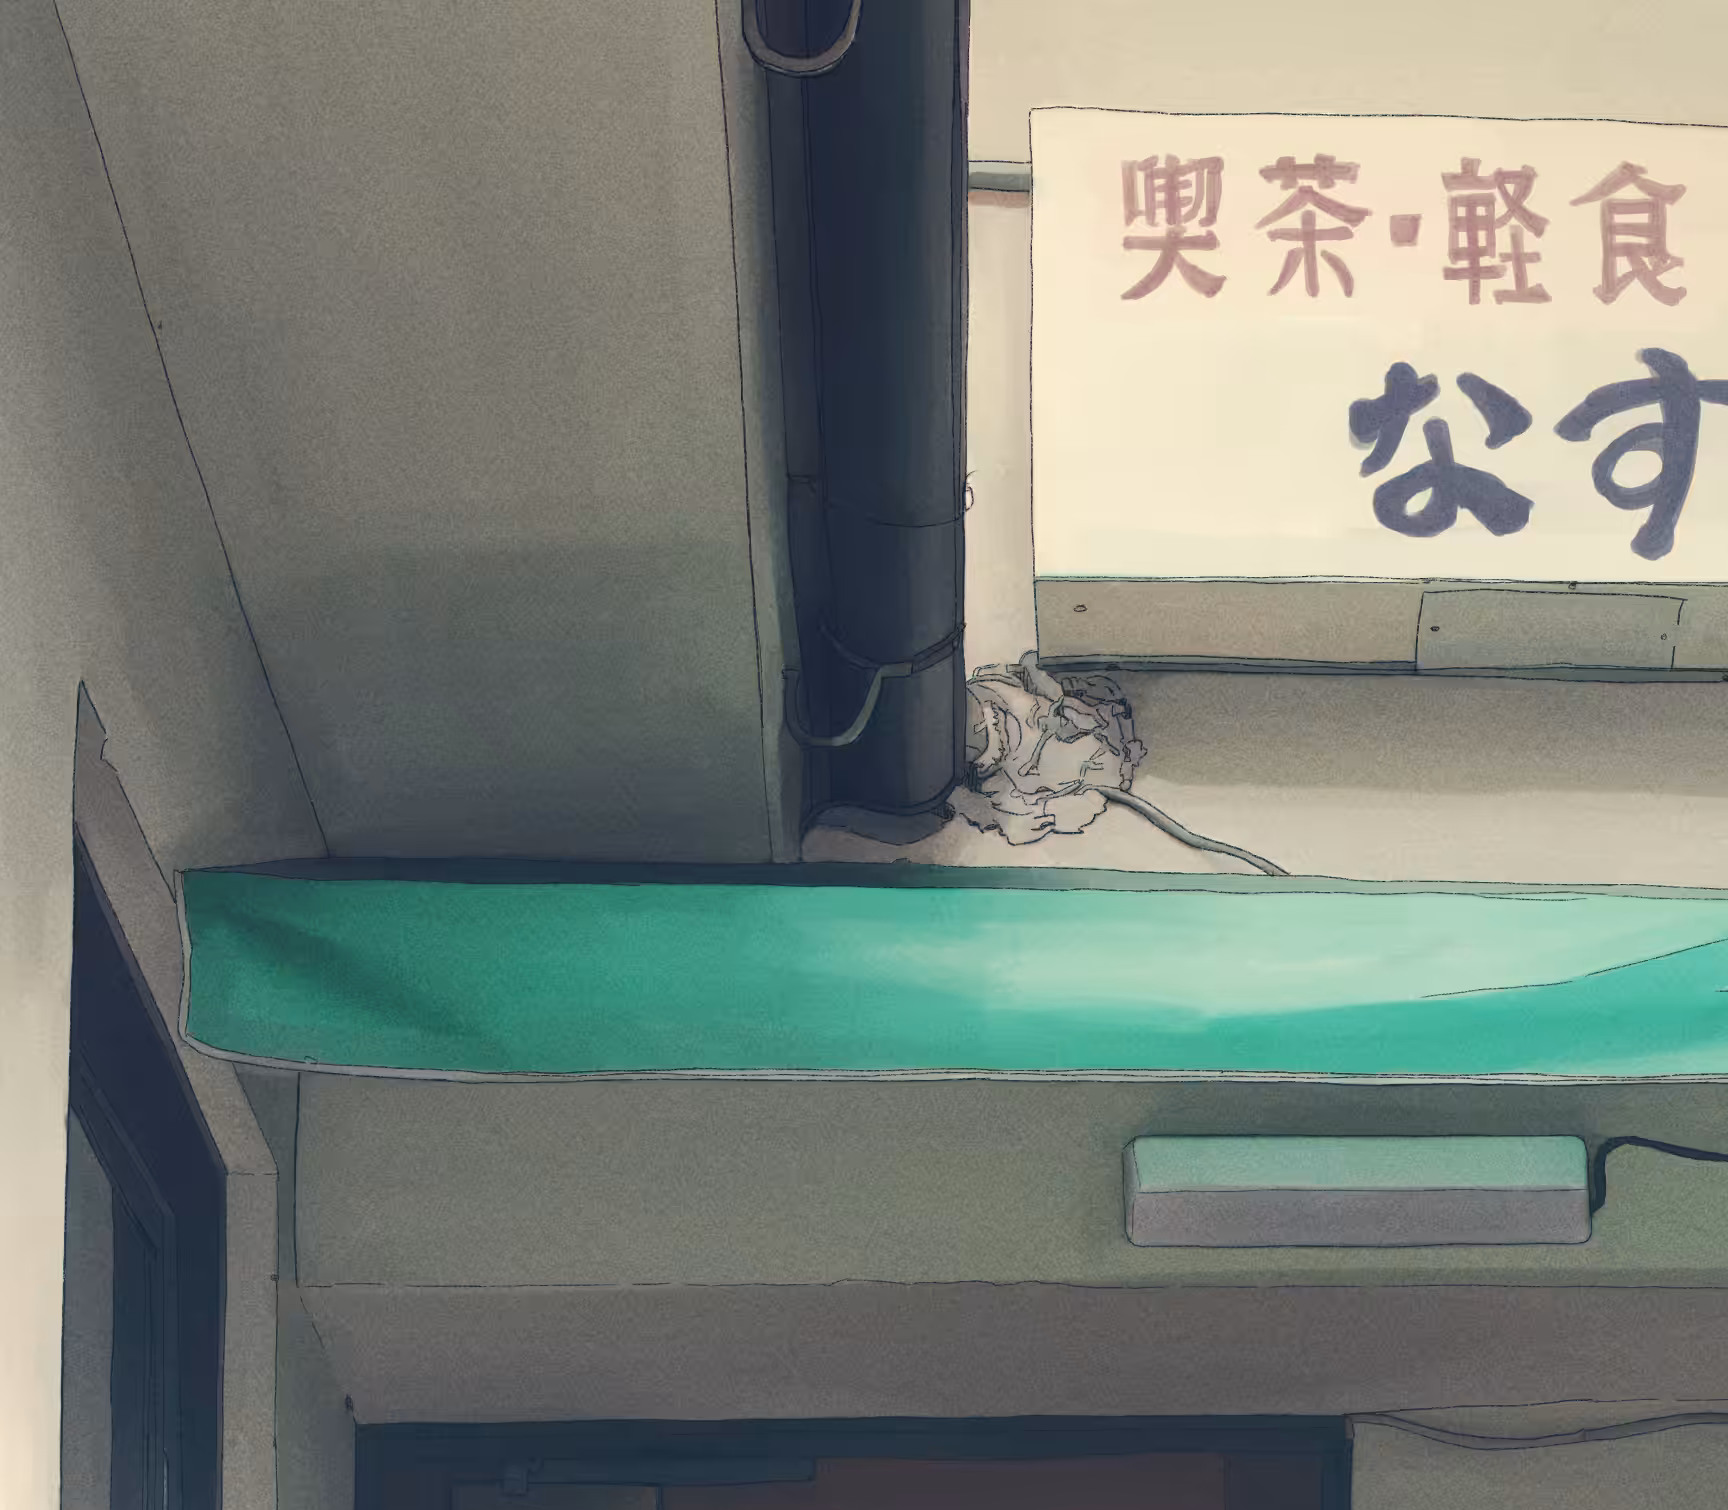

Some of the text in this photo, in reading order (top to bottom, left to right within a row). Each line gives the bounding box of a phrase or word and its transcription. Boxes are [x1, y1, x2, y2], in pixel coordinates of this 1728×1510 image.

[1119, 155, 1690, 306] 喫茶・軽食
